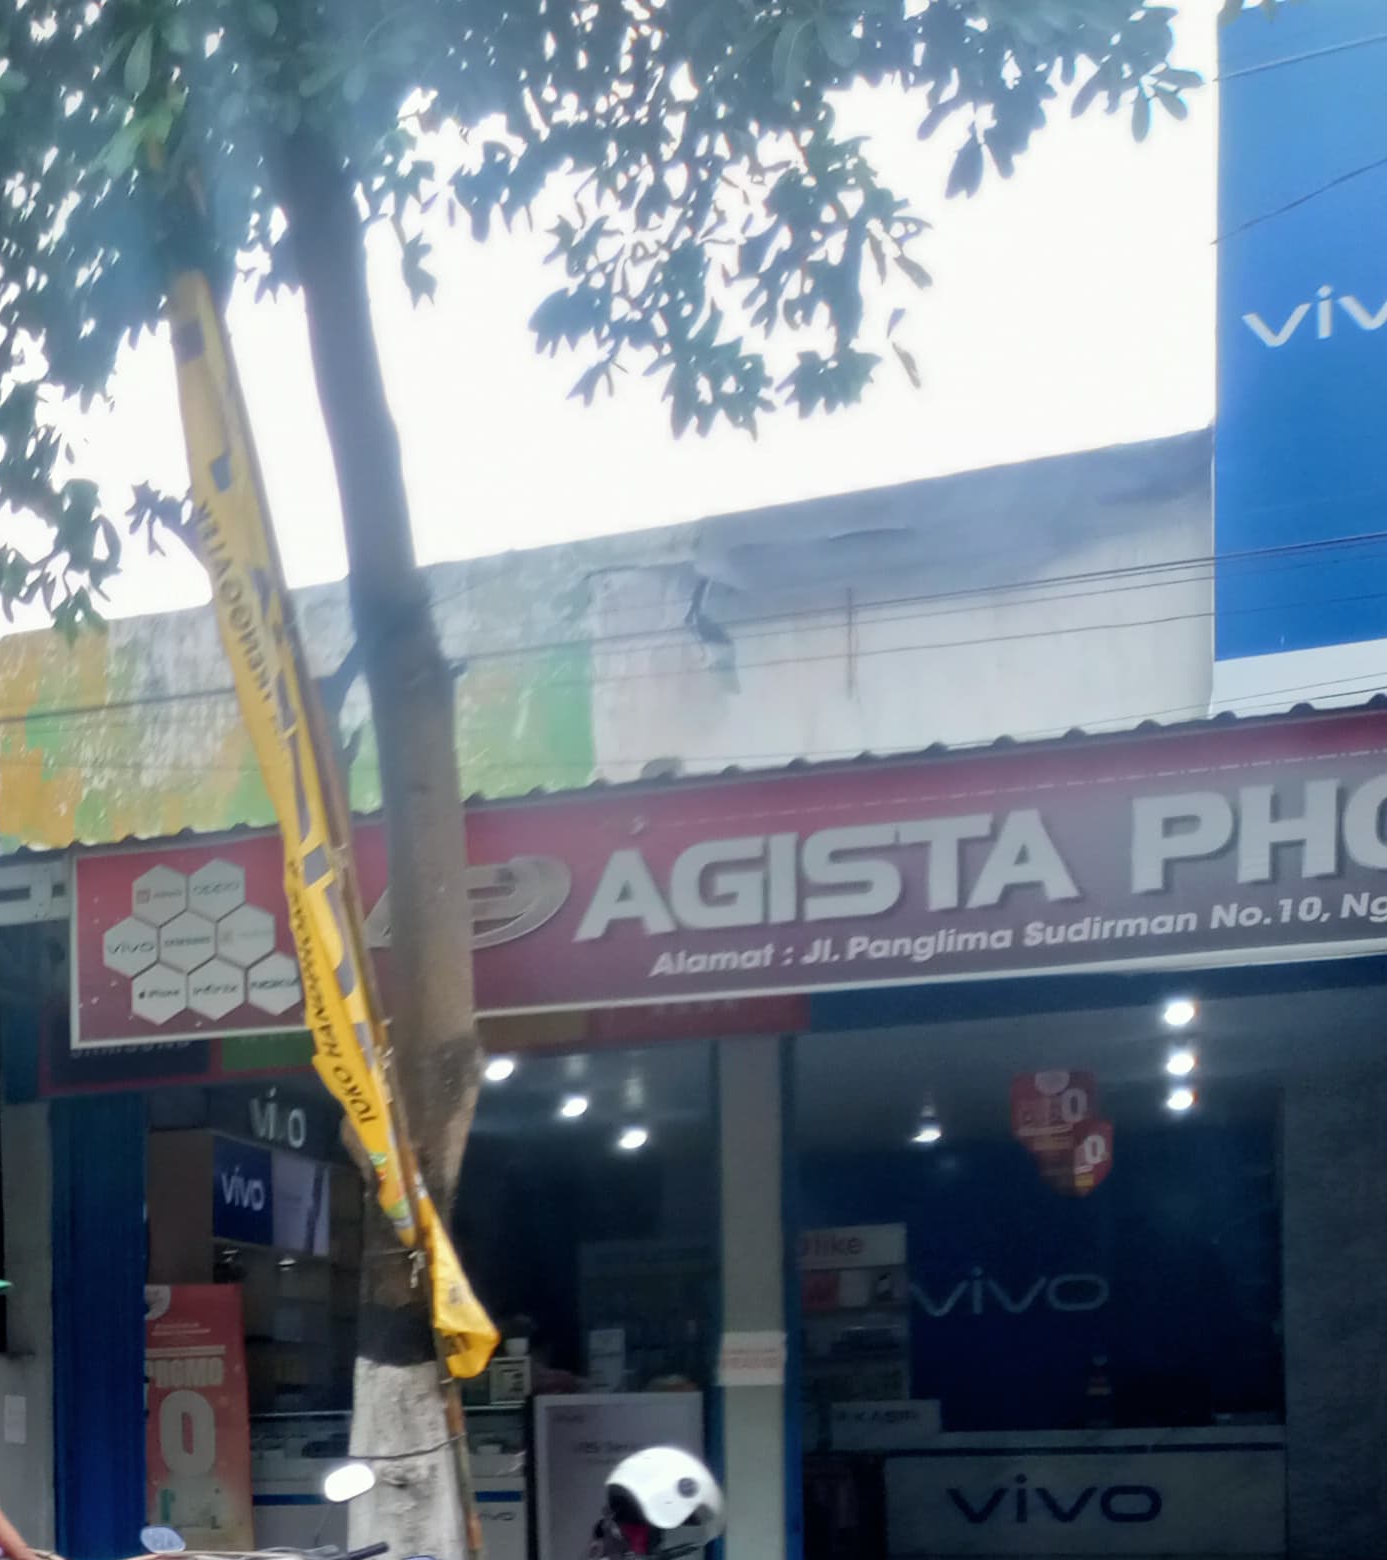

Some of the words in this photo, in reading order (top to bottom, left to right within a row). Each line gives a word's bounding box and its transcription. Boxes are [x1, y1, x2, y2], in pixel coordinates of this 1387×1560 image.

[574, 807, 1080, 943] AGISTA
[648, 943, 775, 978] Alamat
[802, 938, 839, 965] Jl.
[848, 929, 1012, 964] Panglima
[1023, 913, 1197, 947] Sudirman
[221, 1164, 266, 1212] vivo
[910, 1265, 1110, 1317] vivo
[946, 1473, 1163, 1523] vivo
